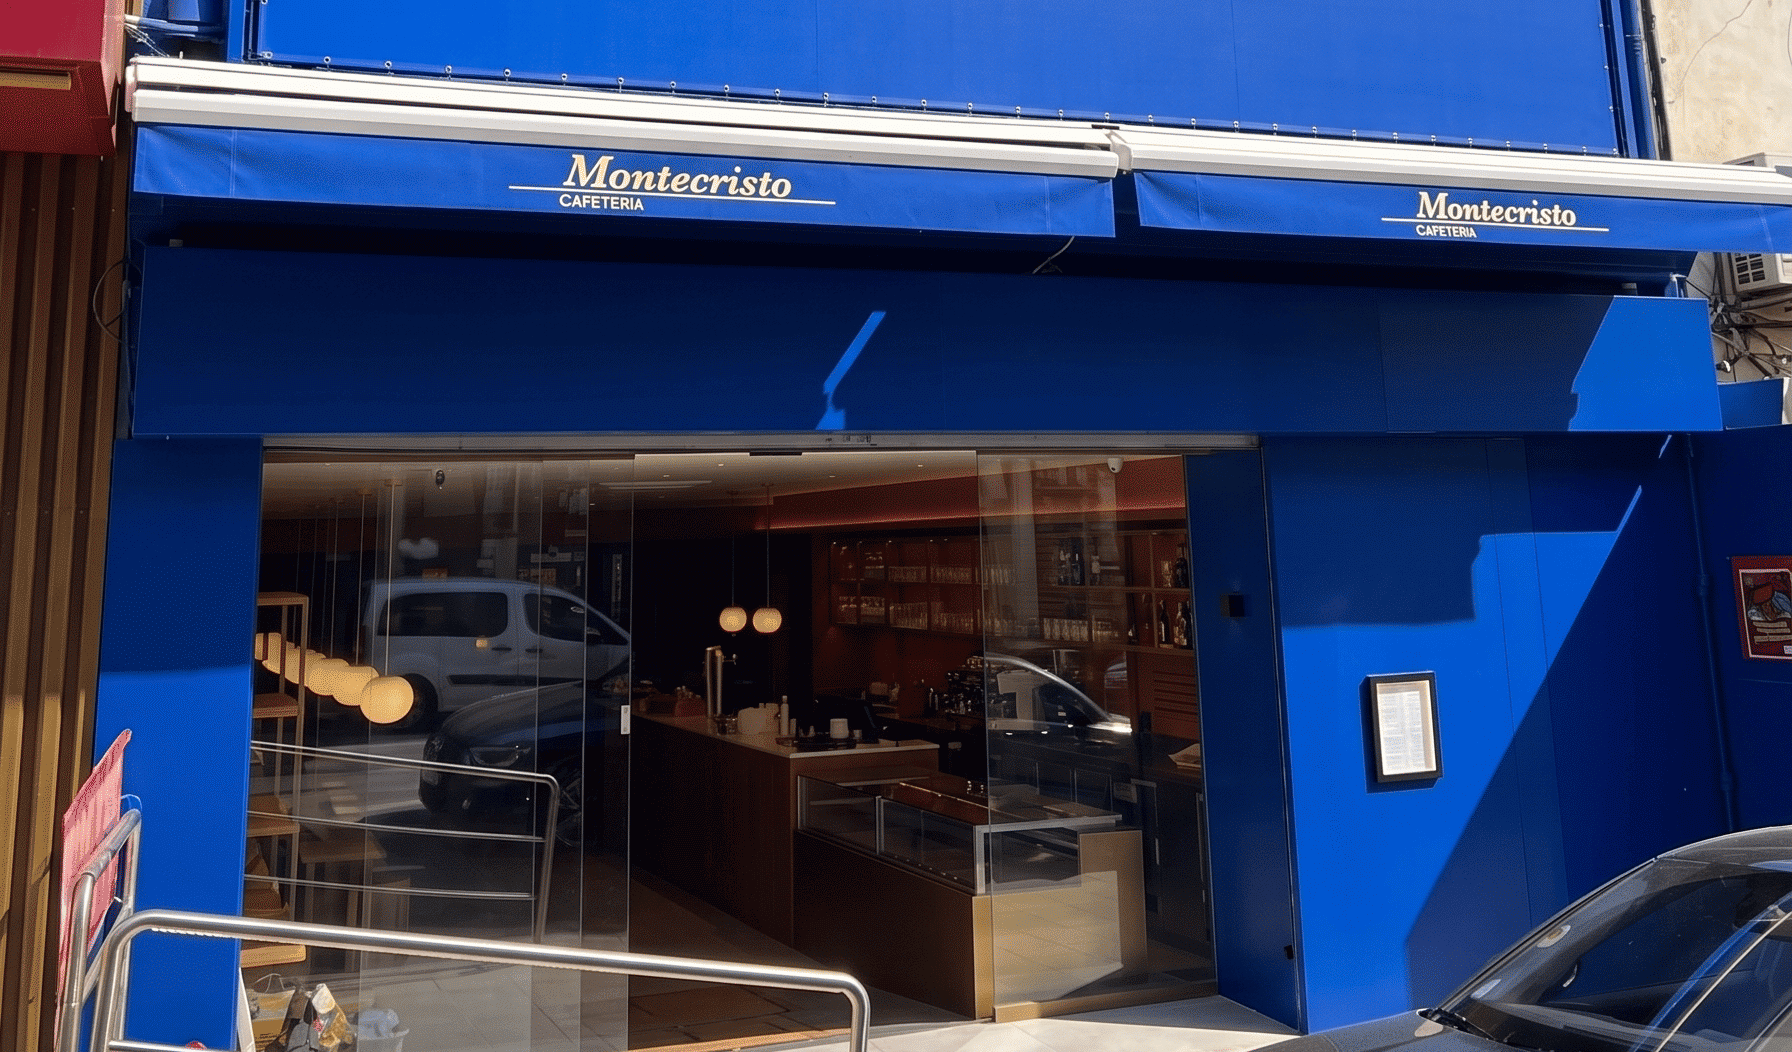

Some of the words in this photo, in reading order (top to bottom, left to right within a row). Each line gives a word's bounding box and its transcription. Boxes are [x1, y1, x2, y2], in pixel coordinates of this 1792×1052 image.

[562, 153, 792, 198] Montecristo
[559, 193, 644, 211] CAFETERIA
[1416, 191, 1577, 227] Montecristo
[1415, 224, 1477, 238] CAFETERIA
